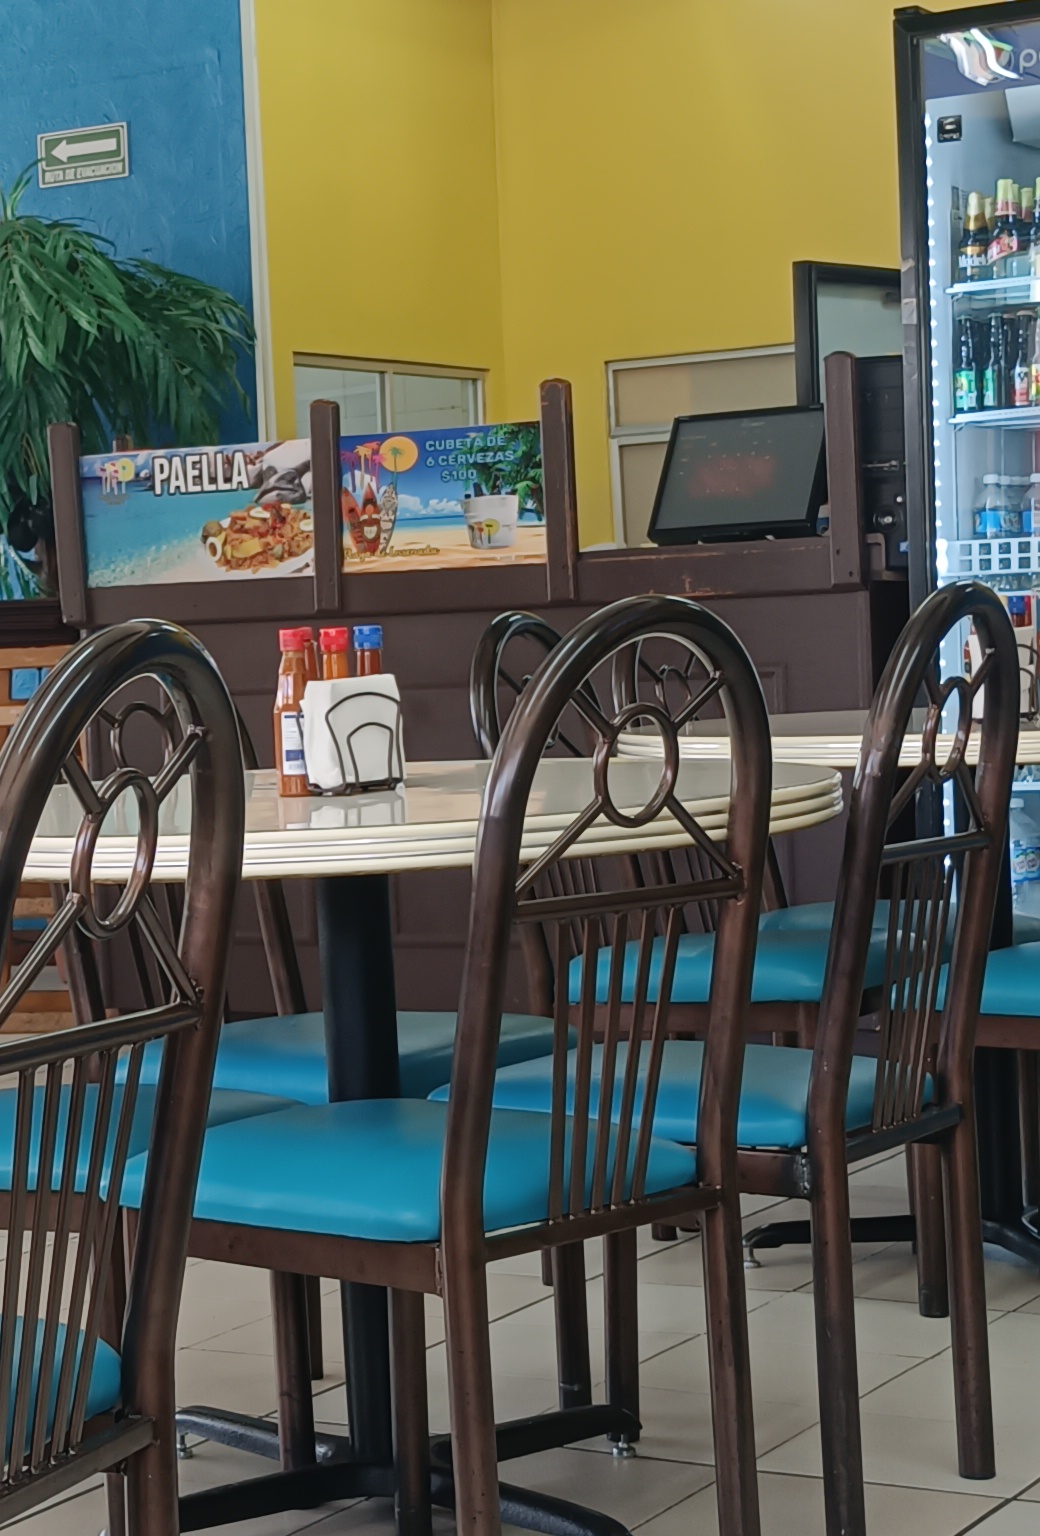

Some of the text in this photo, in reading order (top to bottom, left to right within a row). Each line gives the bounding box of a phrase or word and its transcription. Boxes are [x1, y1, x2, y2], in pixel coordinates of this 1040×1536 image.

[1019, 48, 1040, 74] p
[425, 436, 506, 451] CUBETA DE
[426, 451, 514, 467] 6 CERVEZAS
[153, 451, 250, 496] PAELLA
[442, 469, 477, 482] $100
